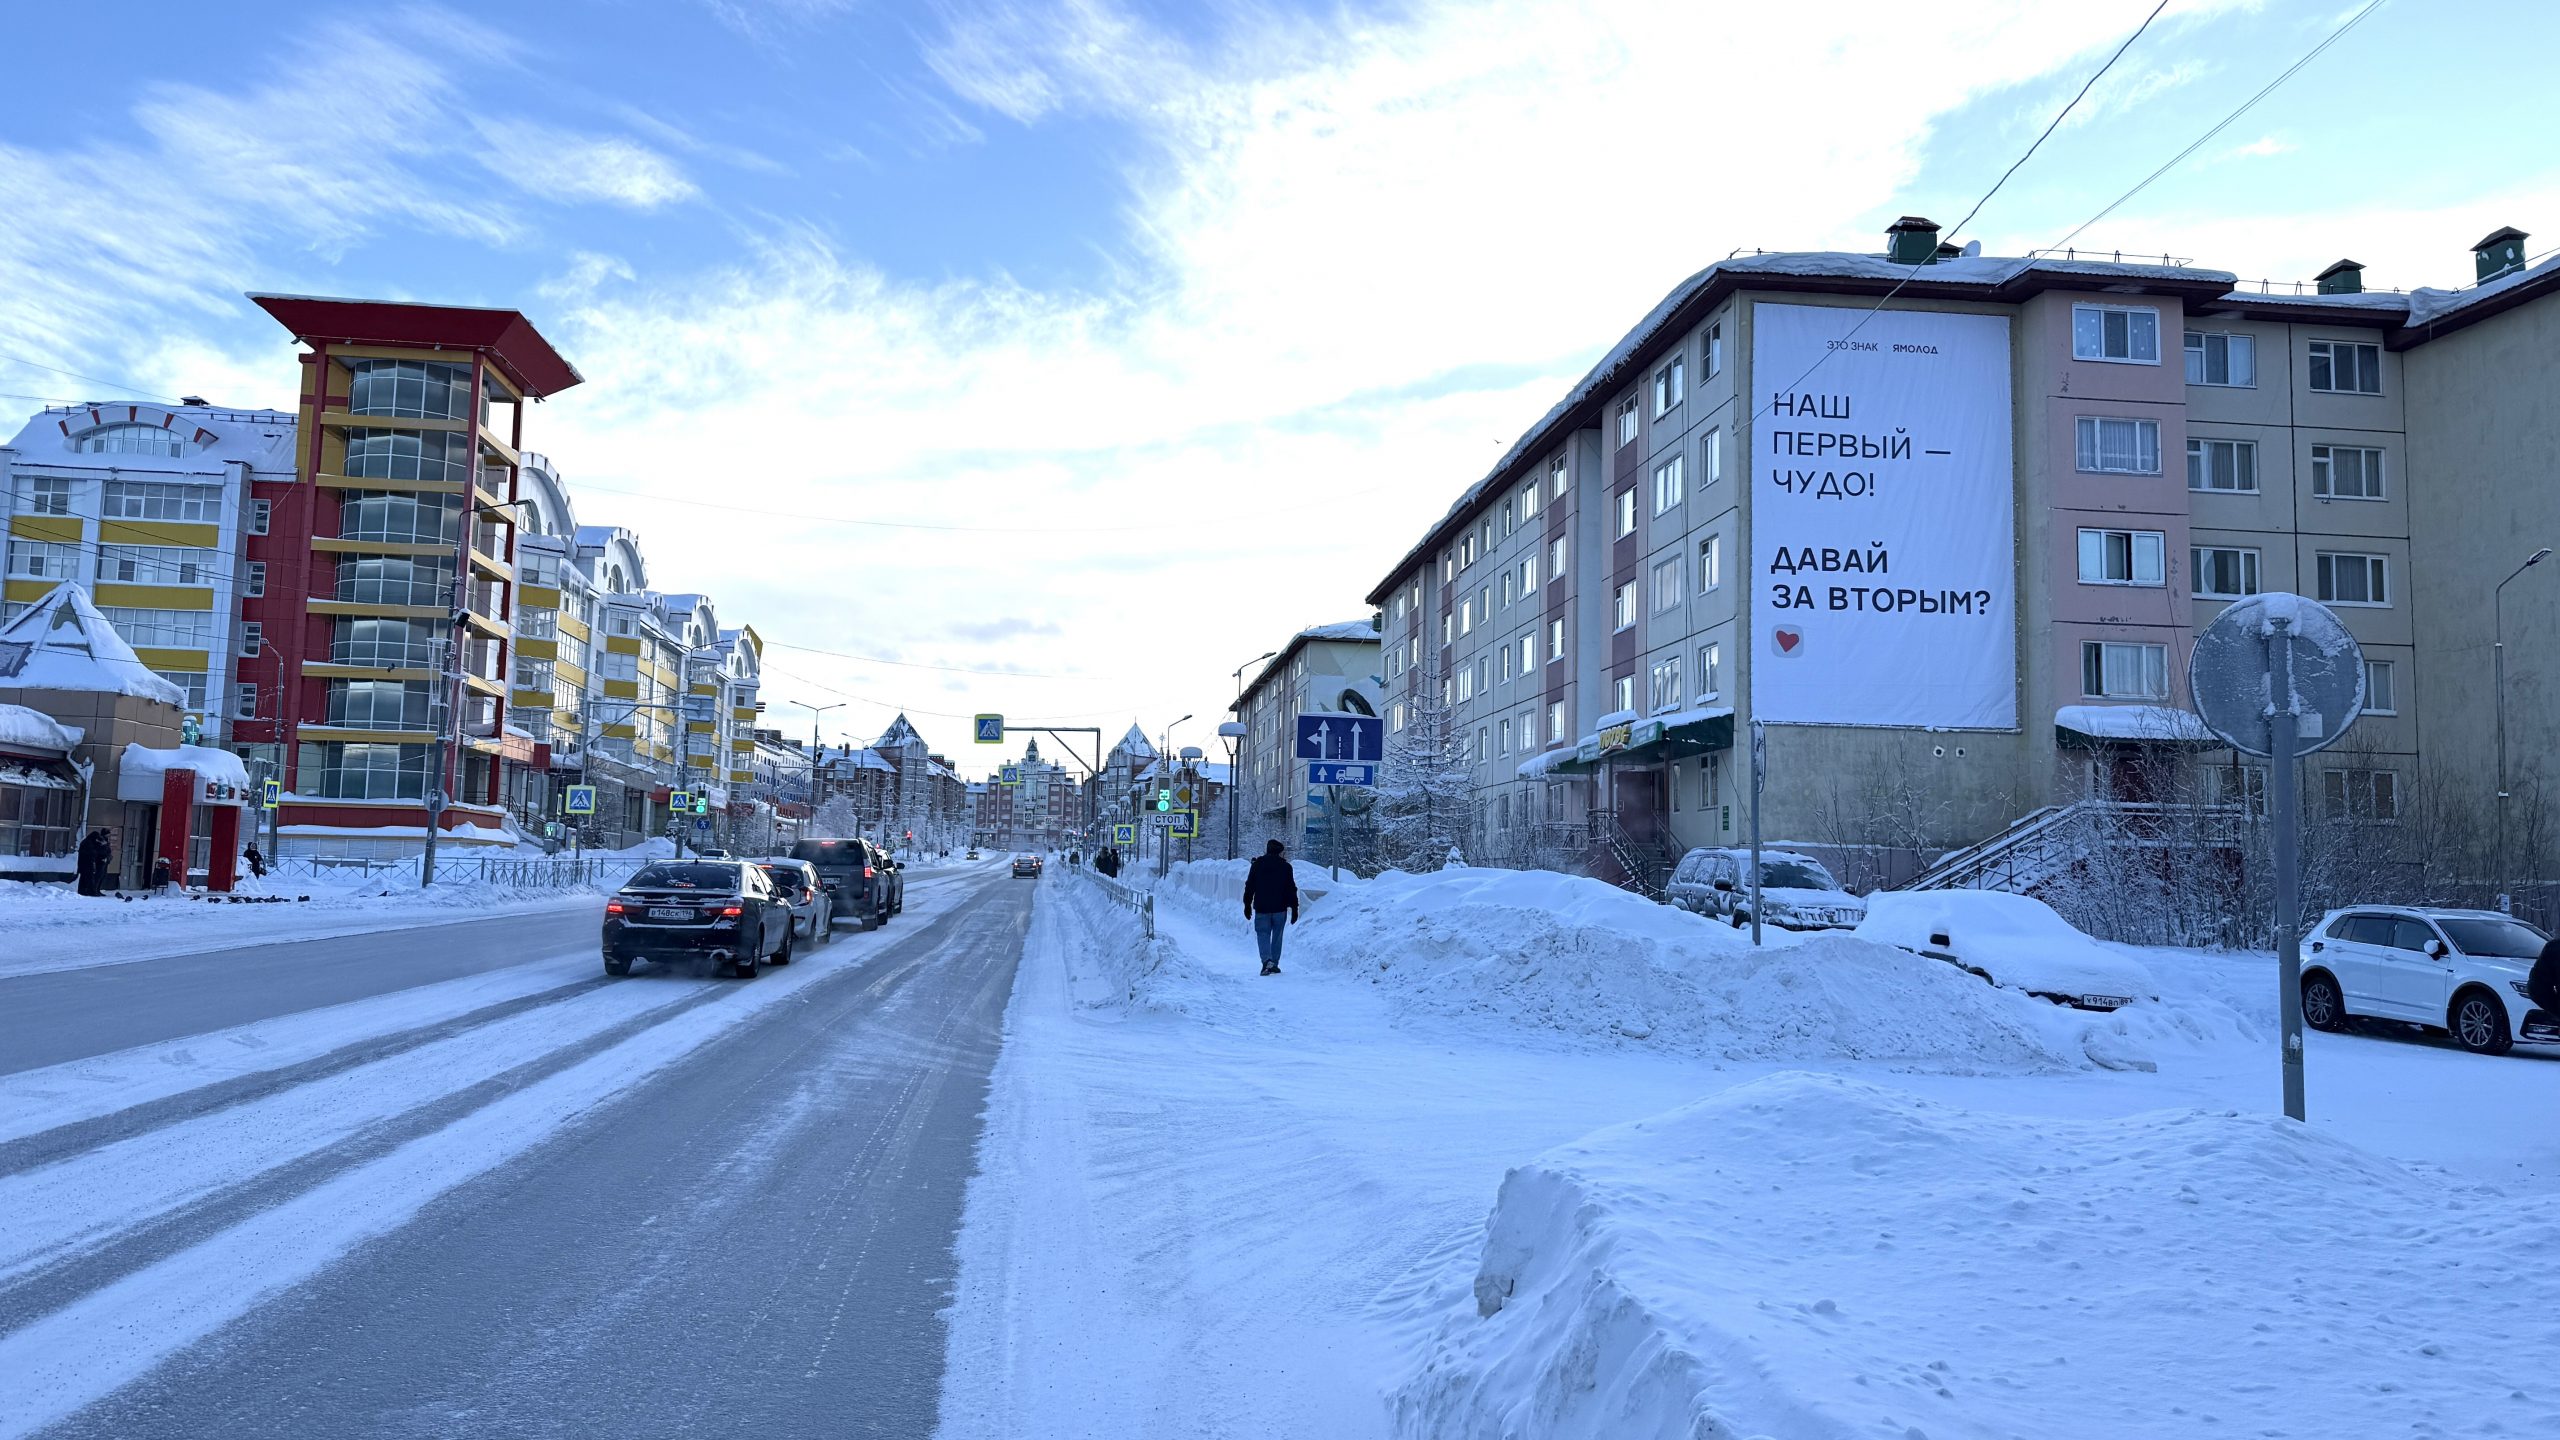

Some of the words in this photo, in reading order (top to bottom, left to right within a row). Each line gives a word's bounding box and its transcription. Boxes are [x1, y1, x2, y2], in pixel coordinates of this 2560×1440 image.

[1826, 340, 1849, 350] ЭТО
[1850, 341, 1879, 352] ЗНАК
[1892, 344, 1939, 355] ЯМОЛОД
[1773, 392, 1850, 419] НАШ
[1773, 427, 1911, 460] ПЕРВЫЙ
[1772, 469, 1874, 500] ЧУДО!
[1770, 541, 1888, 576] ДАВАЙ
[1771, 584, 1815, 610] ЗА
[1828, 586, 1991, 616] ВТОРЫМ?
[1155, 815, 1181, 824] СТОП
